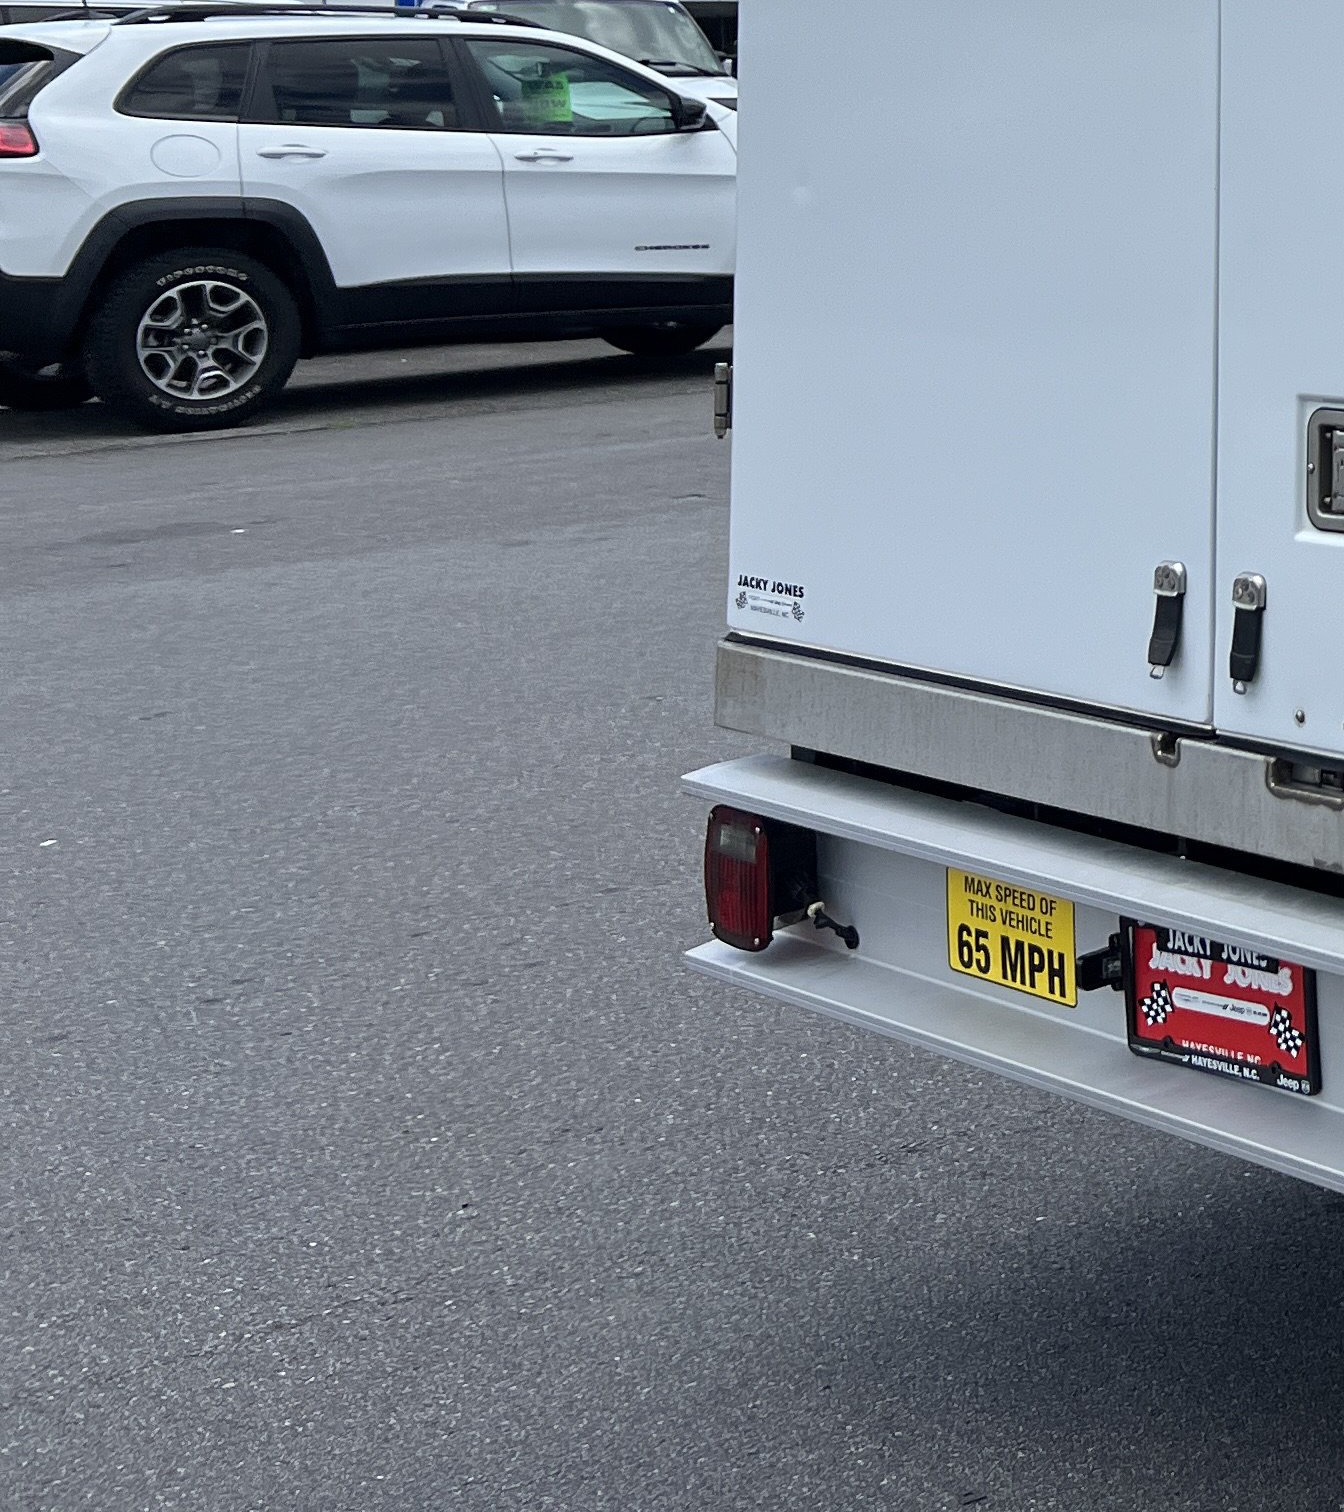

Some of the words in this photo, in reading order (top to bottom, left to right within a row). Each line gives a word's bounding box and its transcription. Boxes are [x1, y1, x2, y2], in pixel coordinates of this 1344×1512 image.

[737, 574, 769, 591] JACKY
[771, 580, 805, 598] JONES
[964, 875, 992, 900] MAX
[995, 884, 1036, 912] SPEED
[1039, 896, 1058, 917] OF
[968, 898, 997, 924] THIS
[1000, 907, 1053, 940] VEHICLE
[1166, 928, 1212, 956] JACKY
[957, 922, 991, 975] 65
[1000, 934, 1067, 999] MPH
[1148, 942, 1214, 980] JACKY
[1223, 962, 1295, 997] JONES
[1191, 1054, 1243, 1077] HAYESVILLE,
[1242, 1068, 1261, 1081] N.C.
[1276, 1074, 1301, 1092] Jeep
